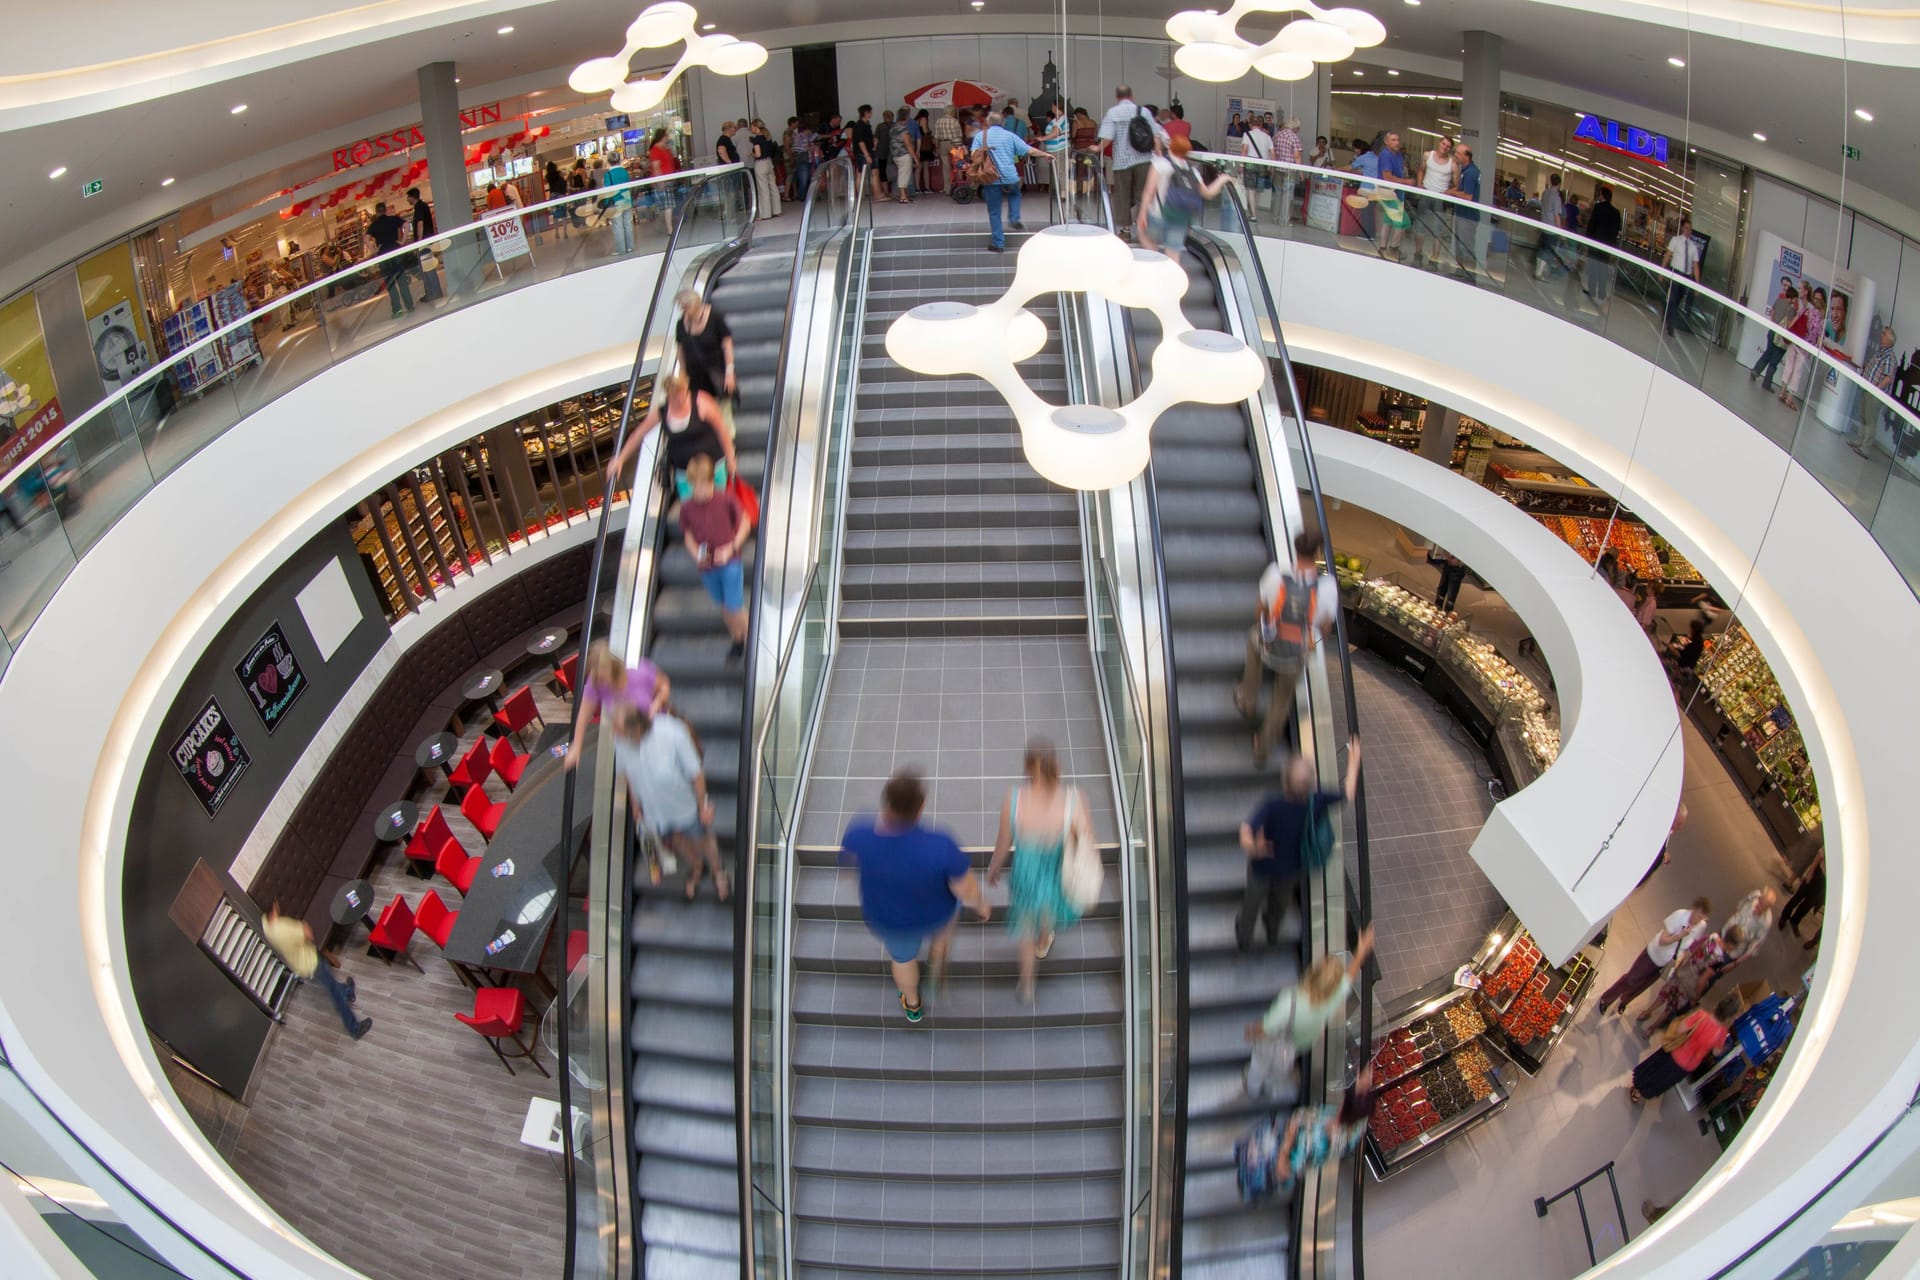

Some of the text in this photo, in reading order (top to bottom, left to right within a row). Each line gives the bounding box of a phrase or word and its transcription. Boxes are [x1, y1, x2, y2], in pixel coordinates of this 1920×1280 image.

[1573, 114, 1668, 163] ALDI
[490, 219, 519, 238] 10%
[27, 407, 58, 441] 2015
[176, 704, 221, 767] CUPCAKES
